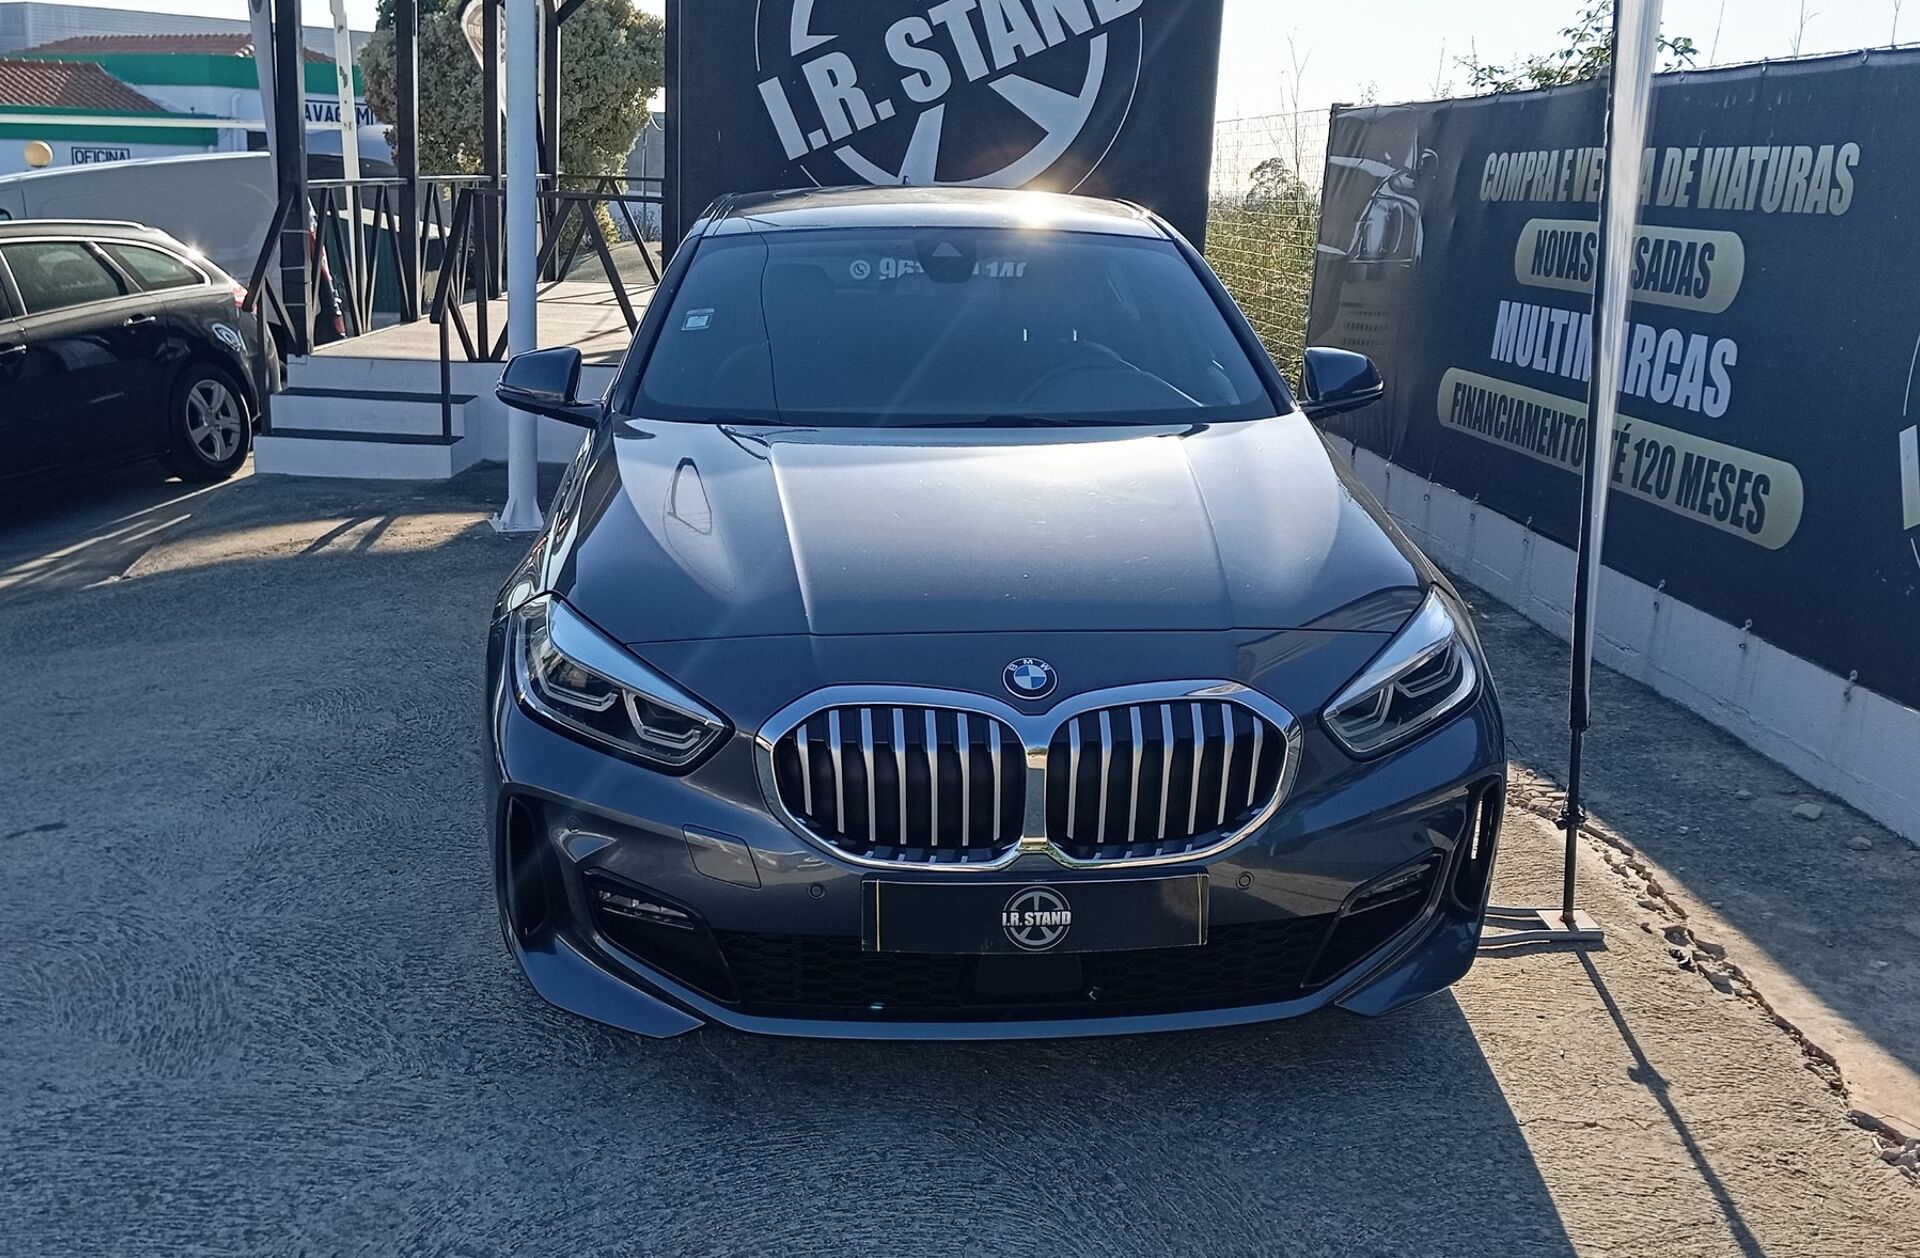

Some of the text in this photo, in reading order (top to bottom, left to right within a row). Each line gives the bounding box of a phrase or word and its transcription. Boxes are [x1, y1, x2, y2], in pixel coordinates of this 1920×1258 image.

[757, 51, 896, 161] I.R.
[74, 150, 126, 164] OFICINA
[1480, 142, 1860, 216] COMPRA E VEA DE VIATURAS
[1530, 229, 1715, 299] NOVAS SADAS
[1450, 382, 1587, 468] FINANCIAMENTO
[1631, 437, 1677, 500] 120
[1675, 451, 1771, 535] MESES
[1008, 659, 1051, 672] BMW
[1002, 911, 1072, 926] I.R. STAND
